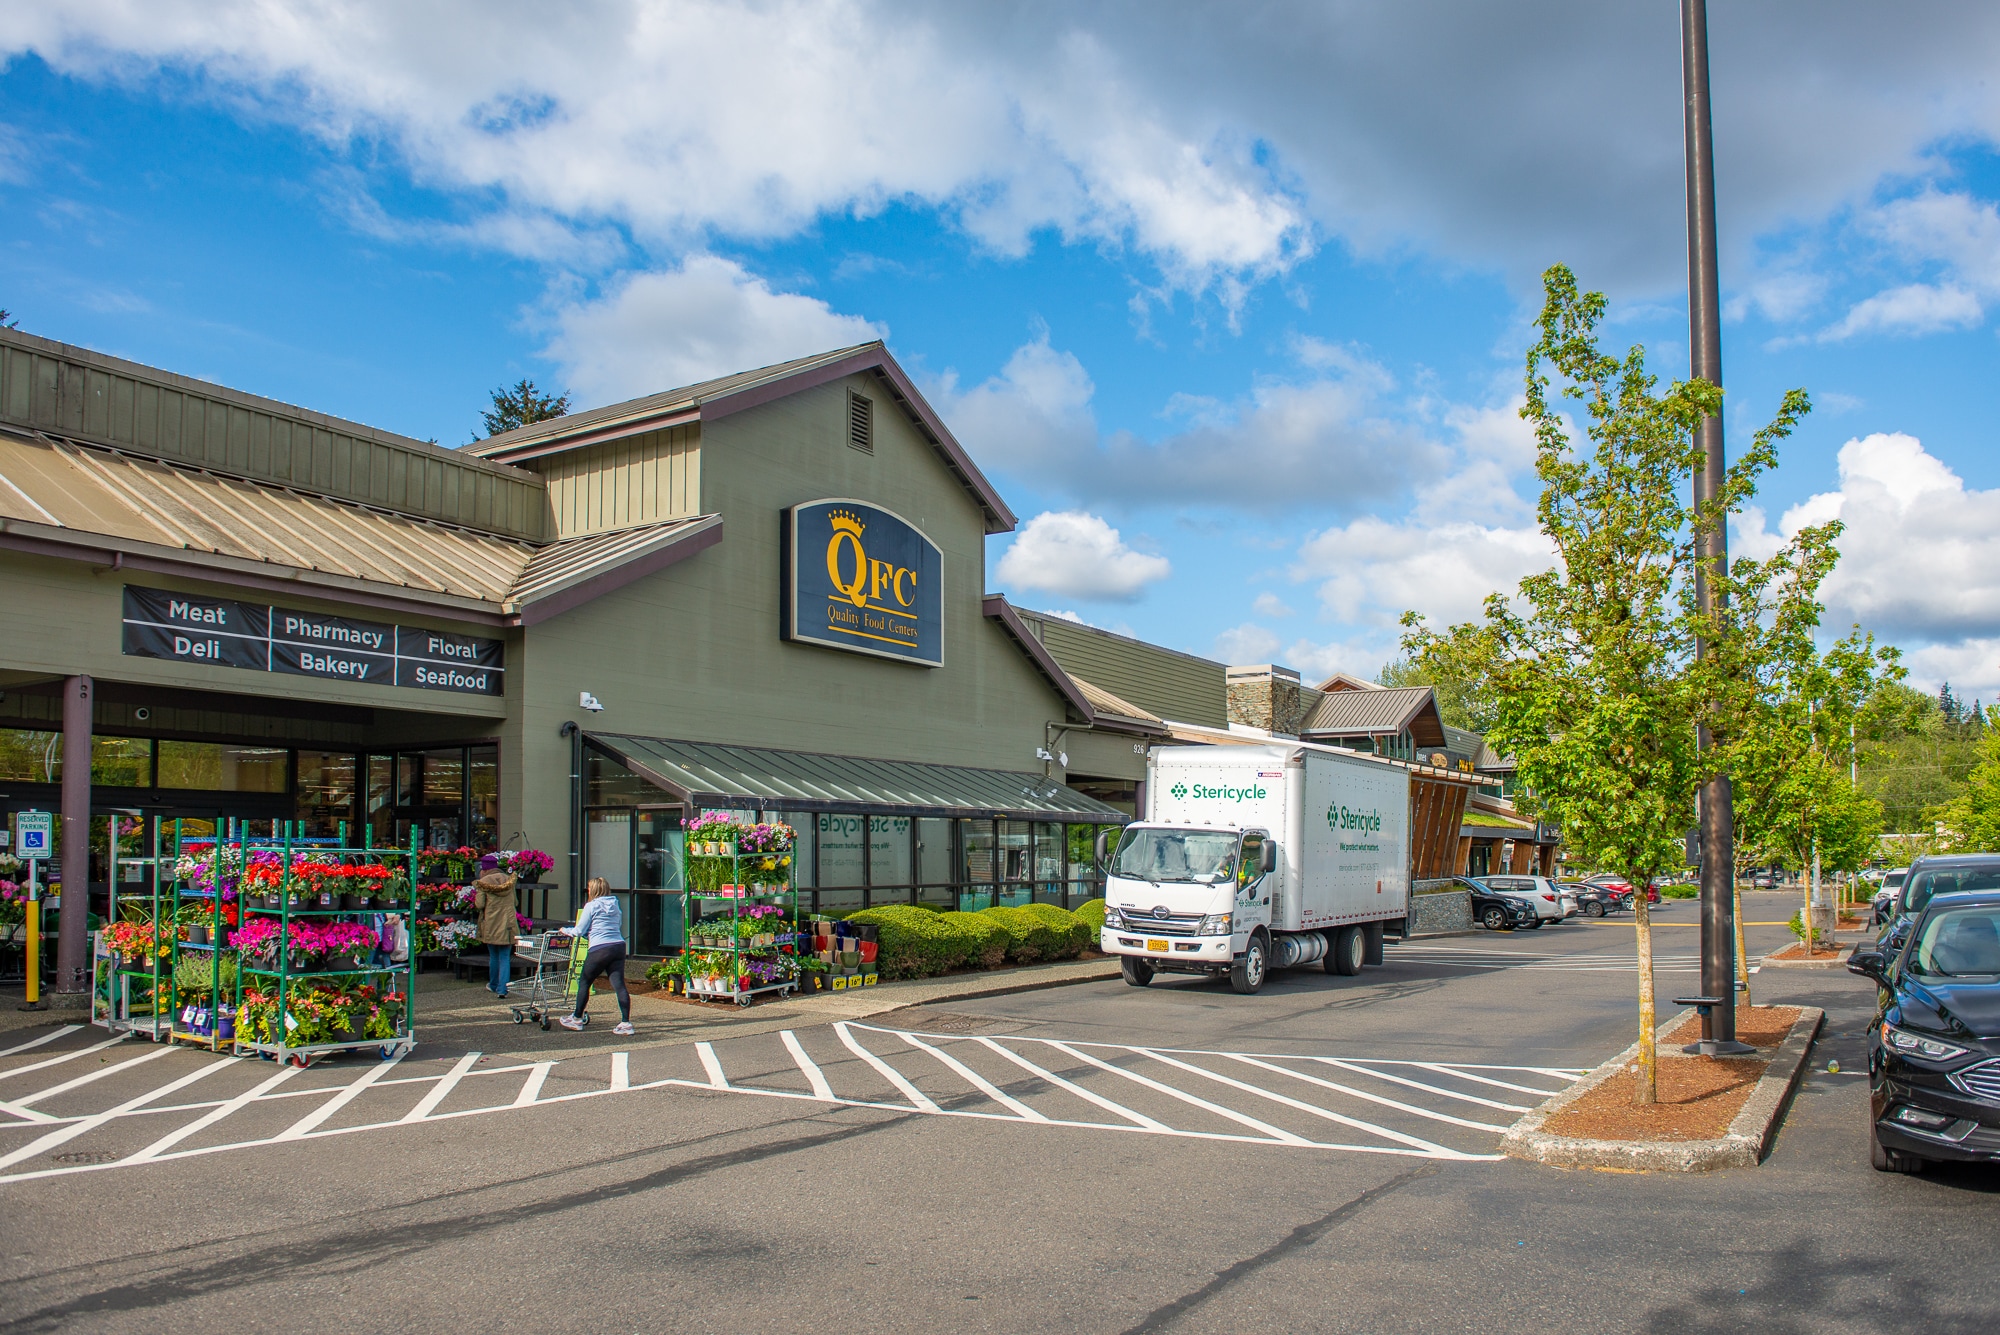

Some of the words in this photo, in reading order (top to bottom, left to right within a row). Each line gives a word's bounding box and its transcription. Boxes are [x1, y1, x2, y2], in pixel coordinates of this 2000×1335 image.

[826, 531, 917, 608] QFC
[169, 601, 226, 625] Meat
[828, 605, 860, 628] Quality
[864, 614, 885, 630] Food
[888, 619, 918, 638] Centers
[285, 617, 383, 648] Pharmacy
[174, 636, 221, 659] Deli
[428, 637, 478, 659] Floral
[300, 652, 369, 680] Bakery
[415, 667, 487, 690] Seafood
[1133, 744, 1145, 754] 926
[1192, 783, 1267, 803] Stericycle
[1340, 805, 1381, 837] Stericycle
